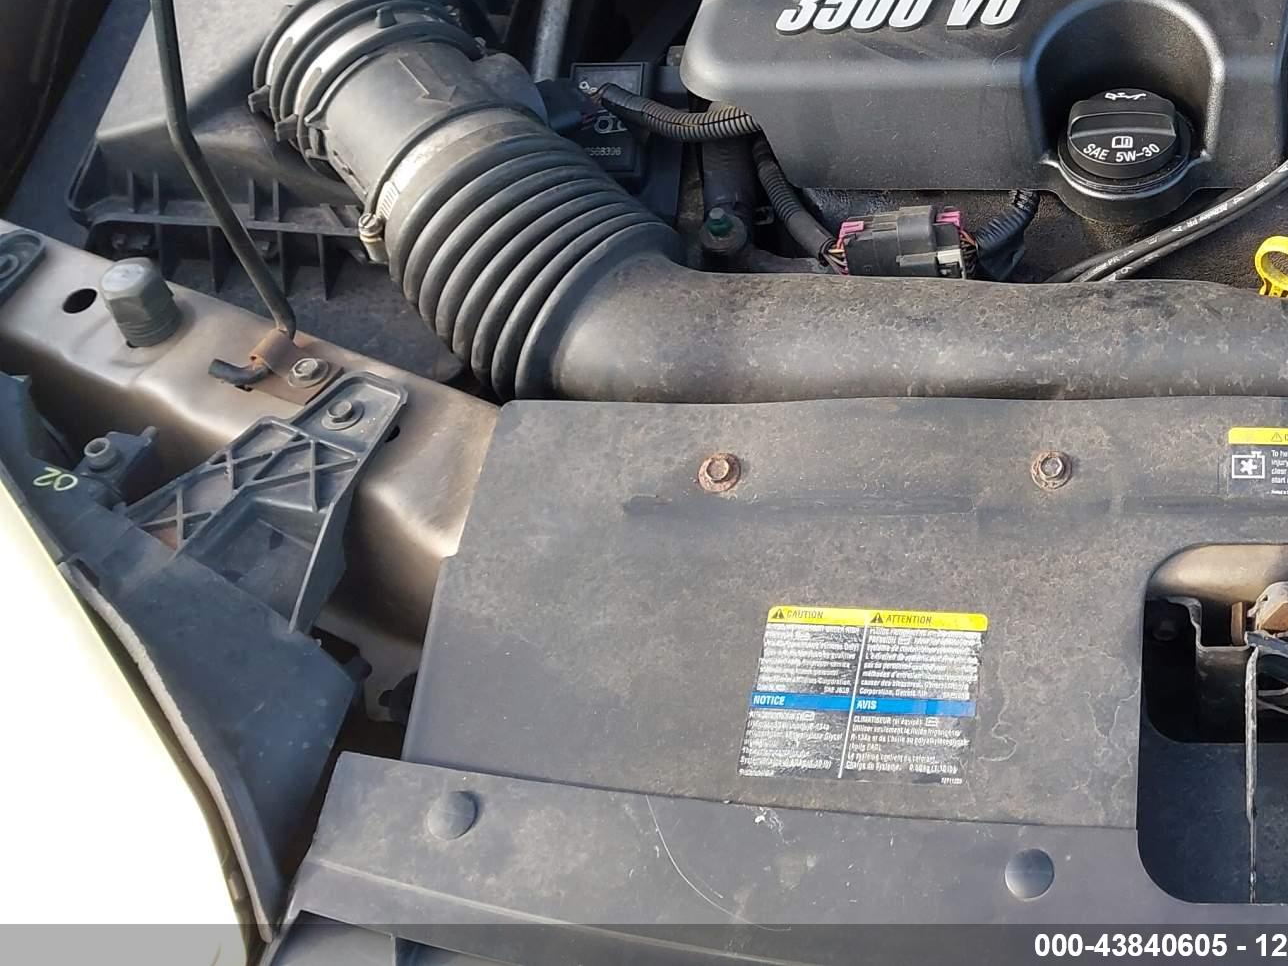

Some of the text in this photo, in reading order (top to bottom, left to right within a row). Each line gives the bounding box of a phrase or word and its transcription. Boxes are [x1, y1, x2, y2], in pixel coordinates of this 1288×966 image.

[1083, 143, 1110, 161] SAE
[786, 610, 824, 619] CAUTION
[885, 614, 932, 624] ATTENTION
[753, 695, 785, 705] NOTICE
[856, 700, 877, 710] AVIS
